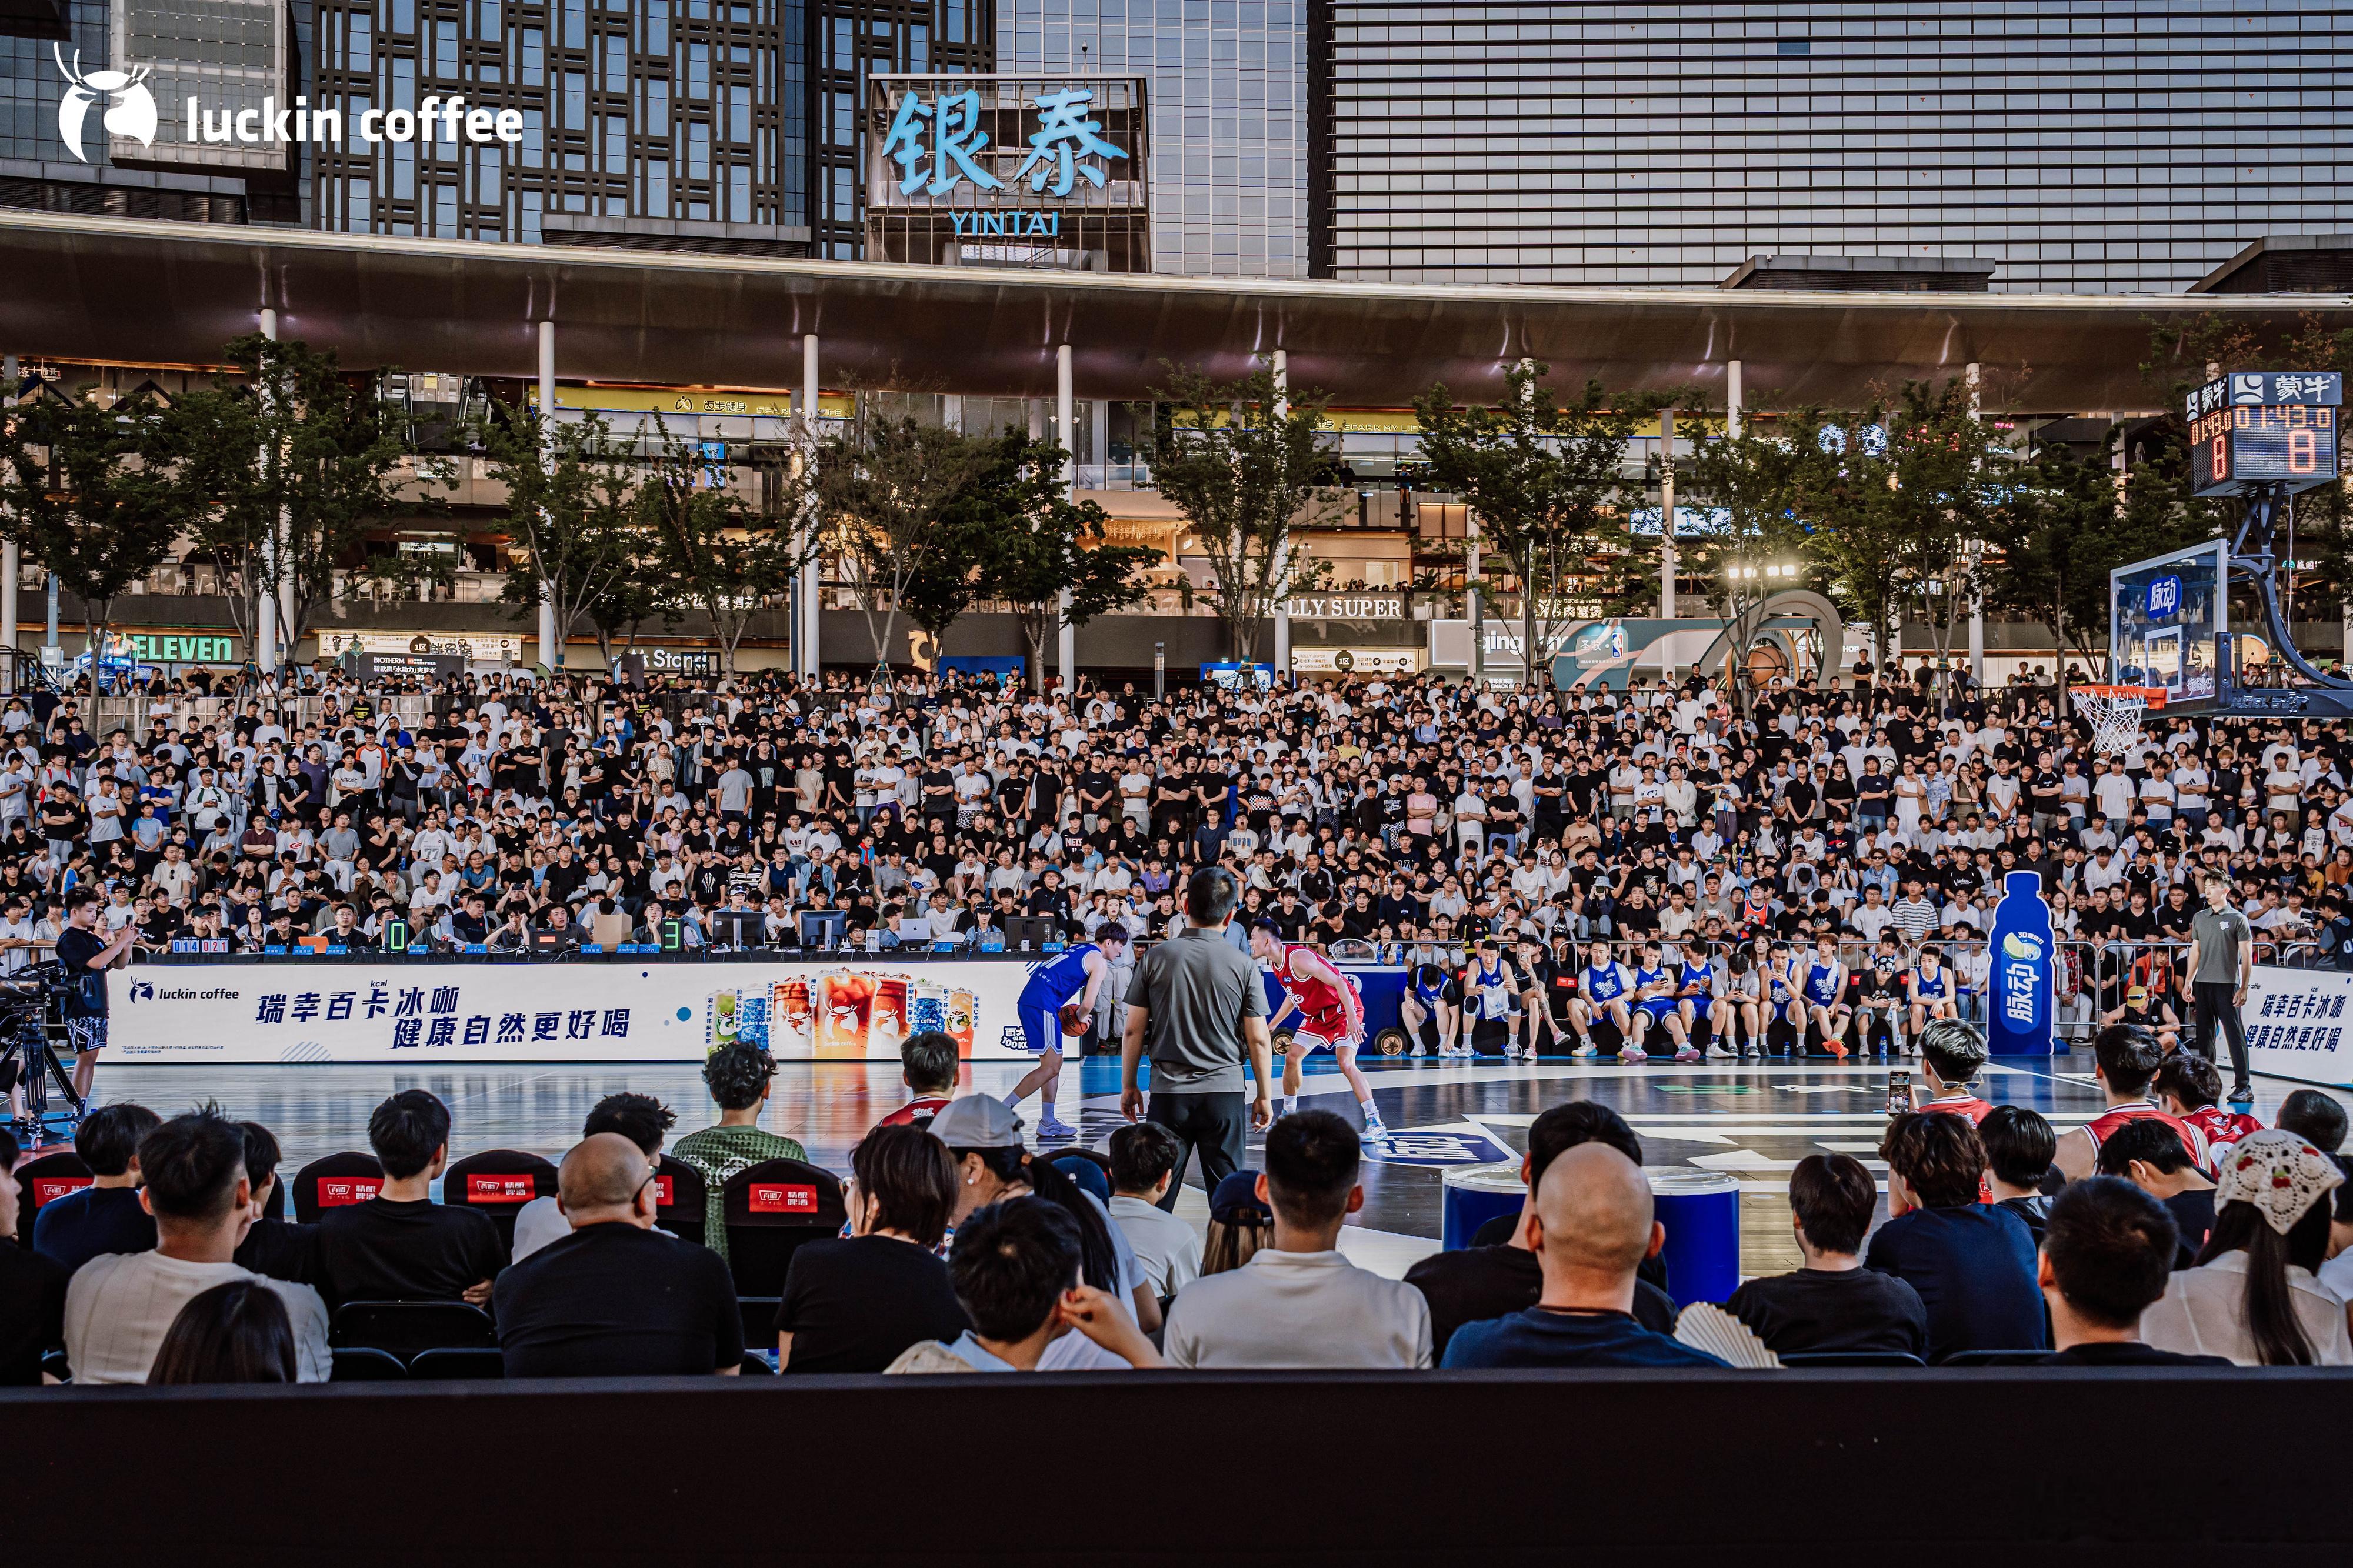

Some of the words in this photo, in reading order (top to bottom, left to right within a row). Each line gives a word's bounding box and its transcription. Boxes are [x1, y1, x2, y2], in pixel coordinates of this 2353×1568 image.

[882, 88, 1129, 197] 银泰
[948, 211, 1059, 237] YINTAI
[2201, 381, 2225, 413] 蒙牛
[2275, 375, 2331, 403] 蒙牛
[704, 400, 747, 412] 迈步健身
[756, 406, 791, 415] SPAR
[2213, 435, 2226, 480] 8
[2289, 429, 2315, 472] 8
[1331, 599, 1402, 617] SUPER
[2149, 578, 2176, 613] 脉动
[414, 643, 427, 652] 1区
[1580, 640, 1601, 652] 圣牧
[373, 656, 405, 665] BIOTHERM
[1065, 838, 1084, 846] NETS
[174, 942, 198, 952] 014
[204, 942, 226, 952] 021
[391, 923, 405, 950] 0
[665, 922, 679, 949] 3
[159, 988, 196, 1000] luckin
[200, 989, 239, 1000] coffee
[370, 979, 388, 988] kcal
[2006, 963, 2041, 1024] 脉动
[255, 985, 461, 1025] 瑞幸百卡冰咖
[1064, 1007, 1076, 1029] Wilson
[2259, 993, 2347, 1019] 瑞幸百卡冰咖
[392, 1007, 631, 1050] 健康自然更好喝
[2245, 1024, 2343, 1053] 健康自然更好喝
[355, 1185, 376, 1193] 精酿
